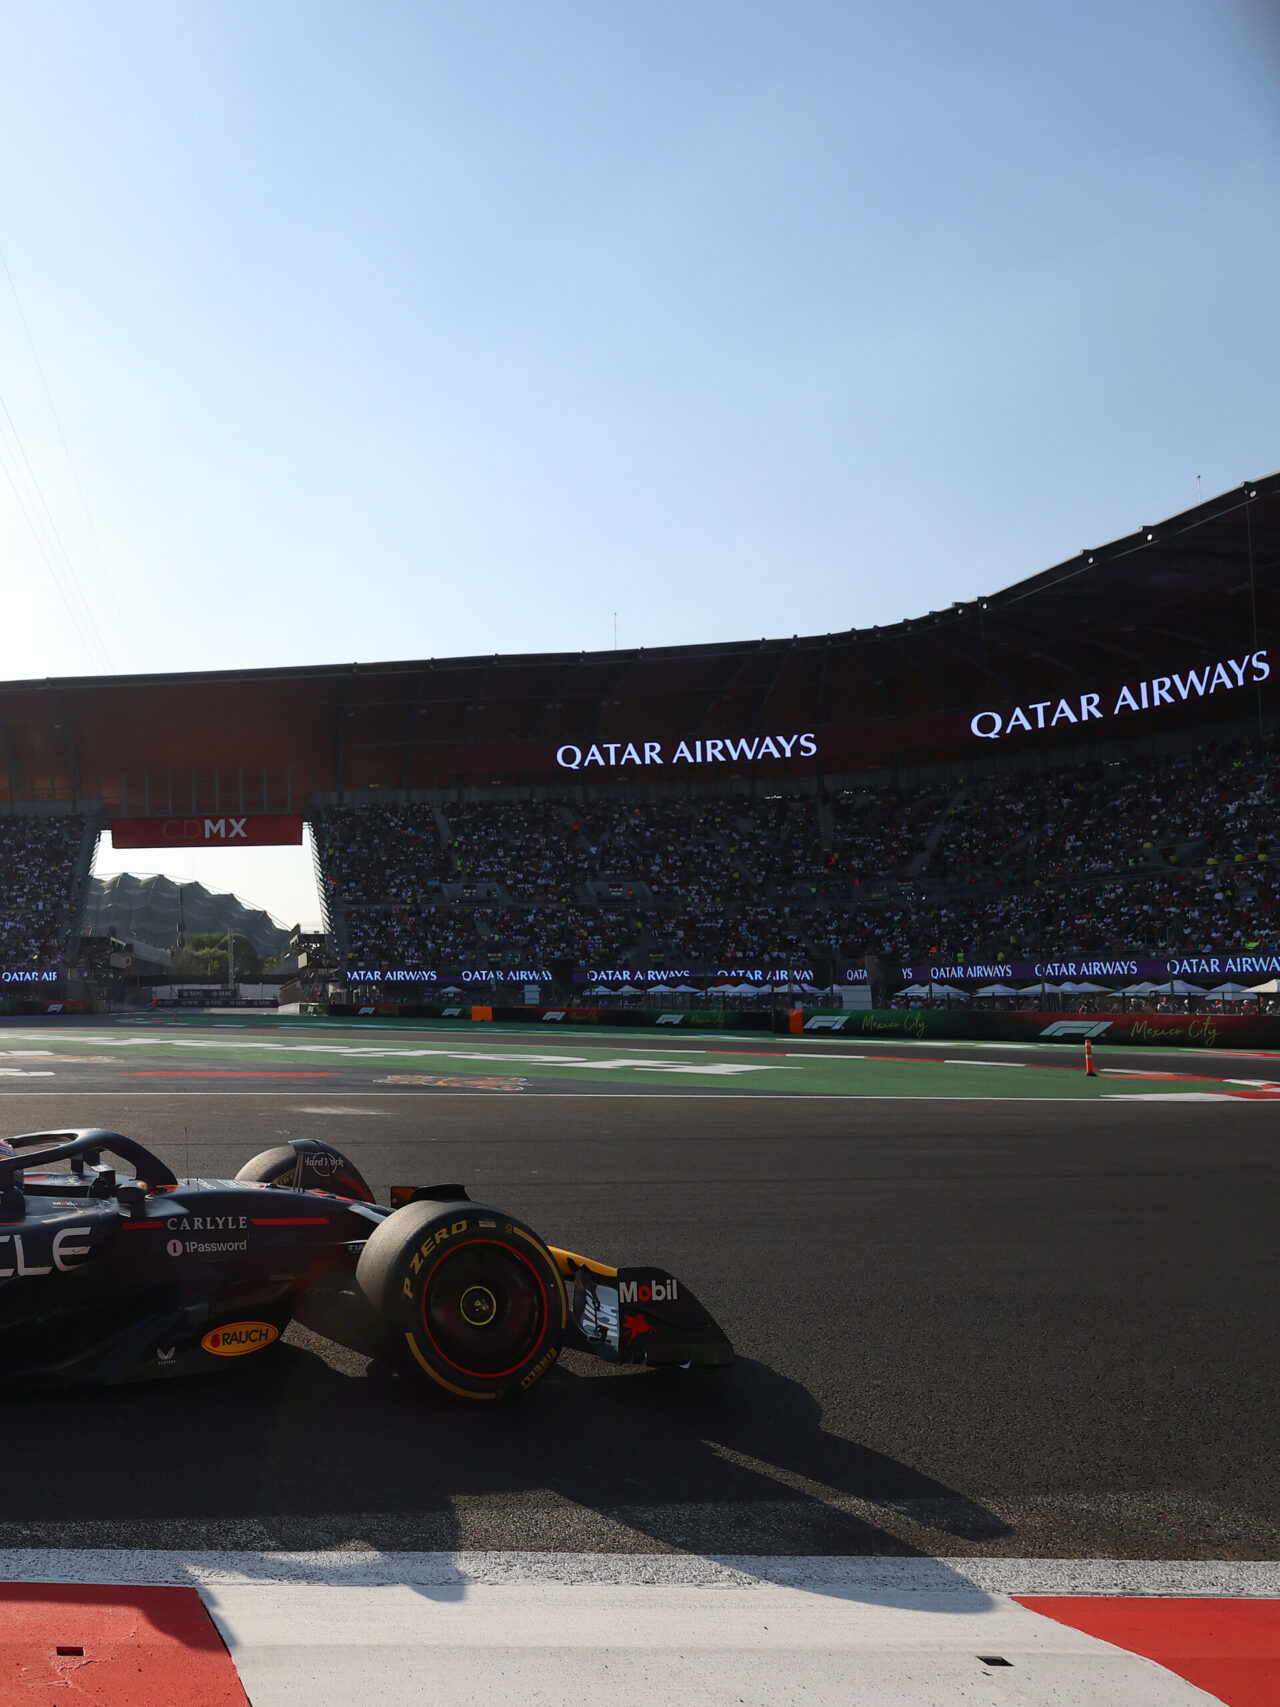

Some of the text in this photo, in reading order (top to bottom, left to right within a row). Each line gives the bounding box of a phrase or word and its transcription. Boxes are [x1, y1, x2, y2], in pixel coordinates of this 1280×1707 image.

[970, 650, 1270, 738] QATAR AIRWAYS
[556, 733, 817, 770] QATAR AIRWAYS
[163, 818, 248, 840] CDMX
[930, 964, 1012, 980] QATAR AIRWAYS
[1080, 961, 1138, 976] AIRWAYS
[1166, 958, 1220, 975] QATAR
[384, 970, 437, 981] AIRWAYS
[586, 970, 631, 981] QATAR
[1131, 1016, 1222, 1046] Mexico City
[167, 1216, 248, 1230] CARLYLE
[185, 1240, 247, 1253] 1Password
[618, 1279, 678, 1303] Mobil
[221, 1328, 270, 1347] RAUCH
